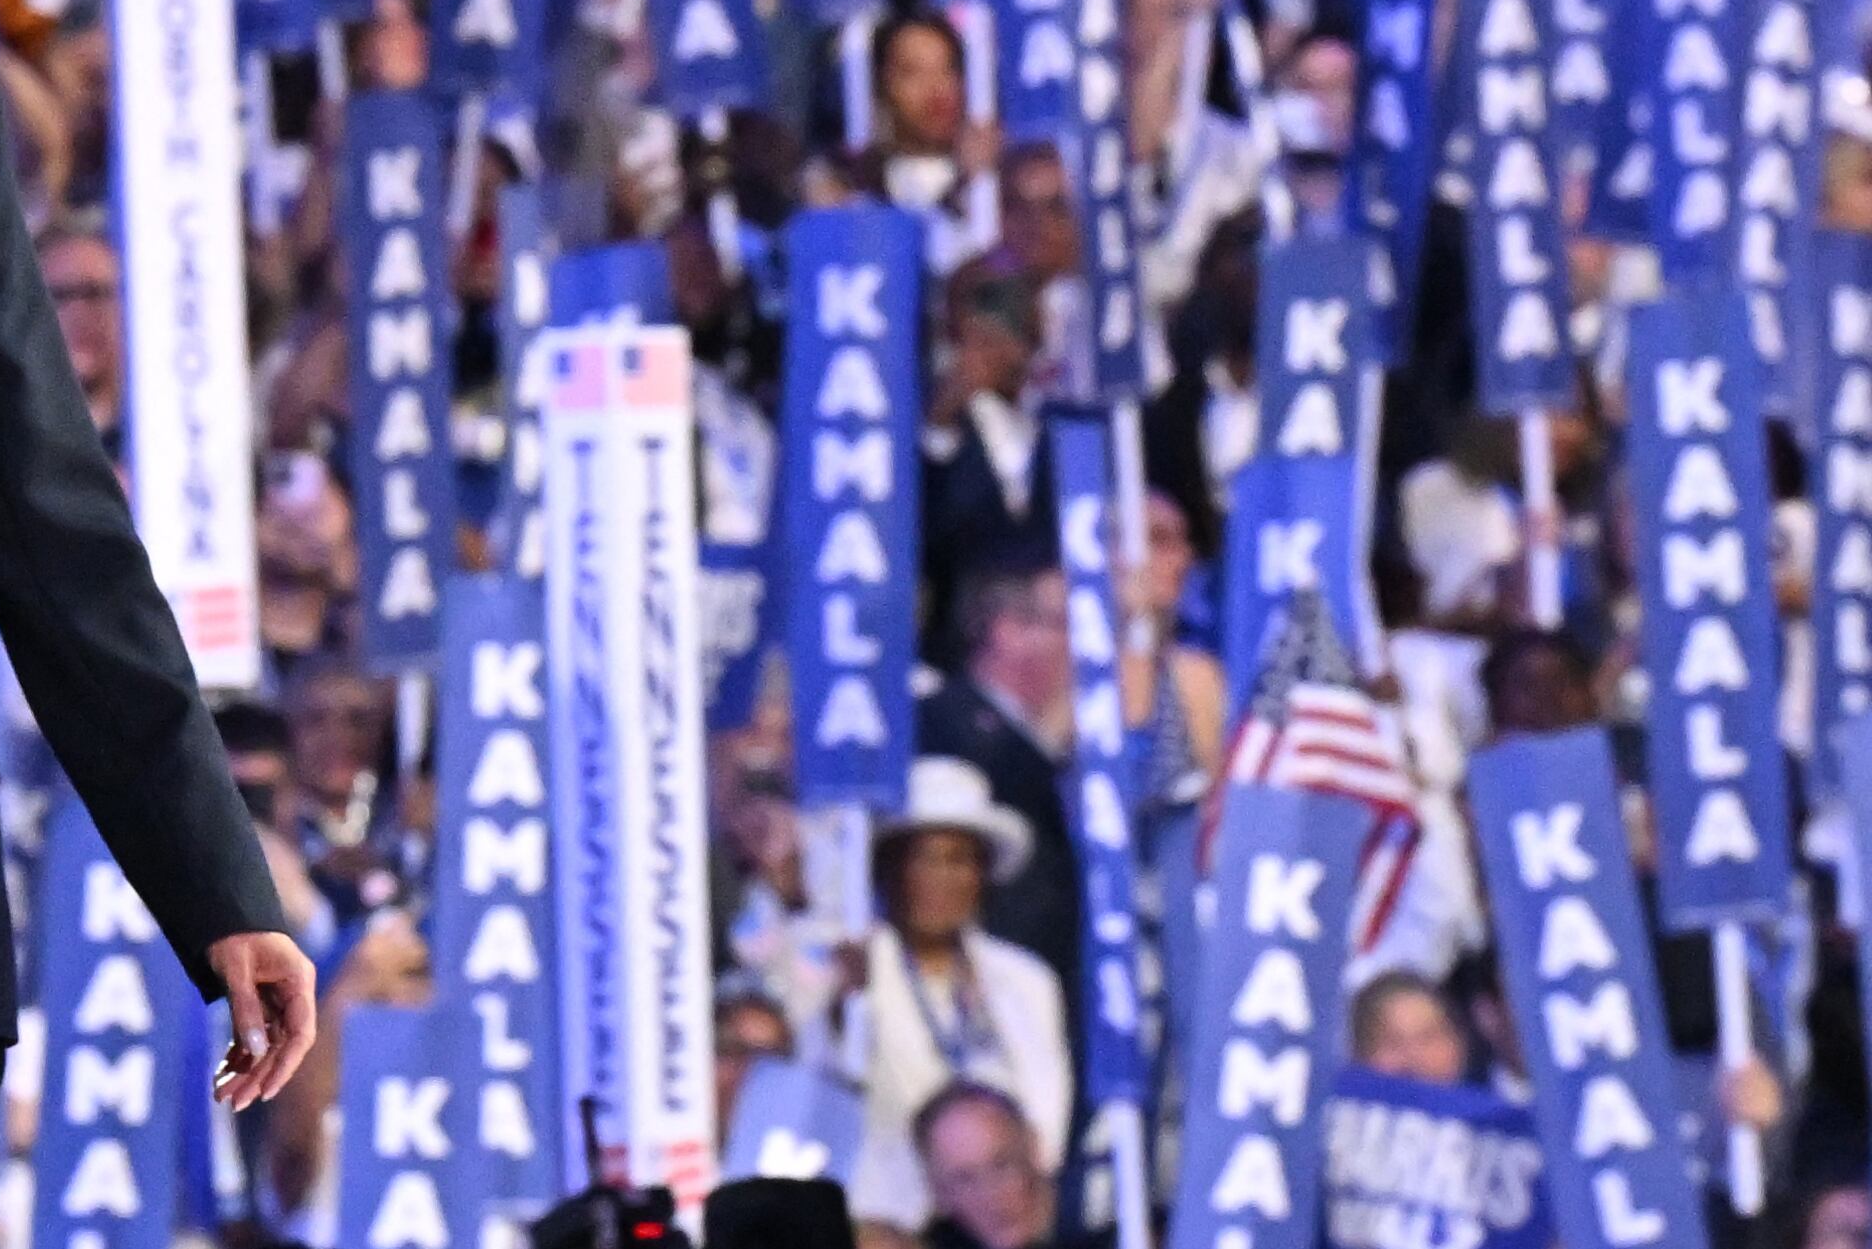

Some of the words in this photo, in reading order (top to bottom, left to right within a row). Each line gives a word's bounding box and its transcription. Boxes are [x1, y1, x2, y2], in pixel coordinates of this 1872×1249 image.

[366, 147, 435, 619] KAMALA
[811, 262, 895, 750] KAMALA
[1654, 356, 1761, 866] KAMALA
[62, 860, 159, 1249] KAMA
[462, 642, 548, 1160] KAMALA
[1210, 852, 1326, 1249] KAMA
